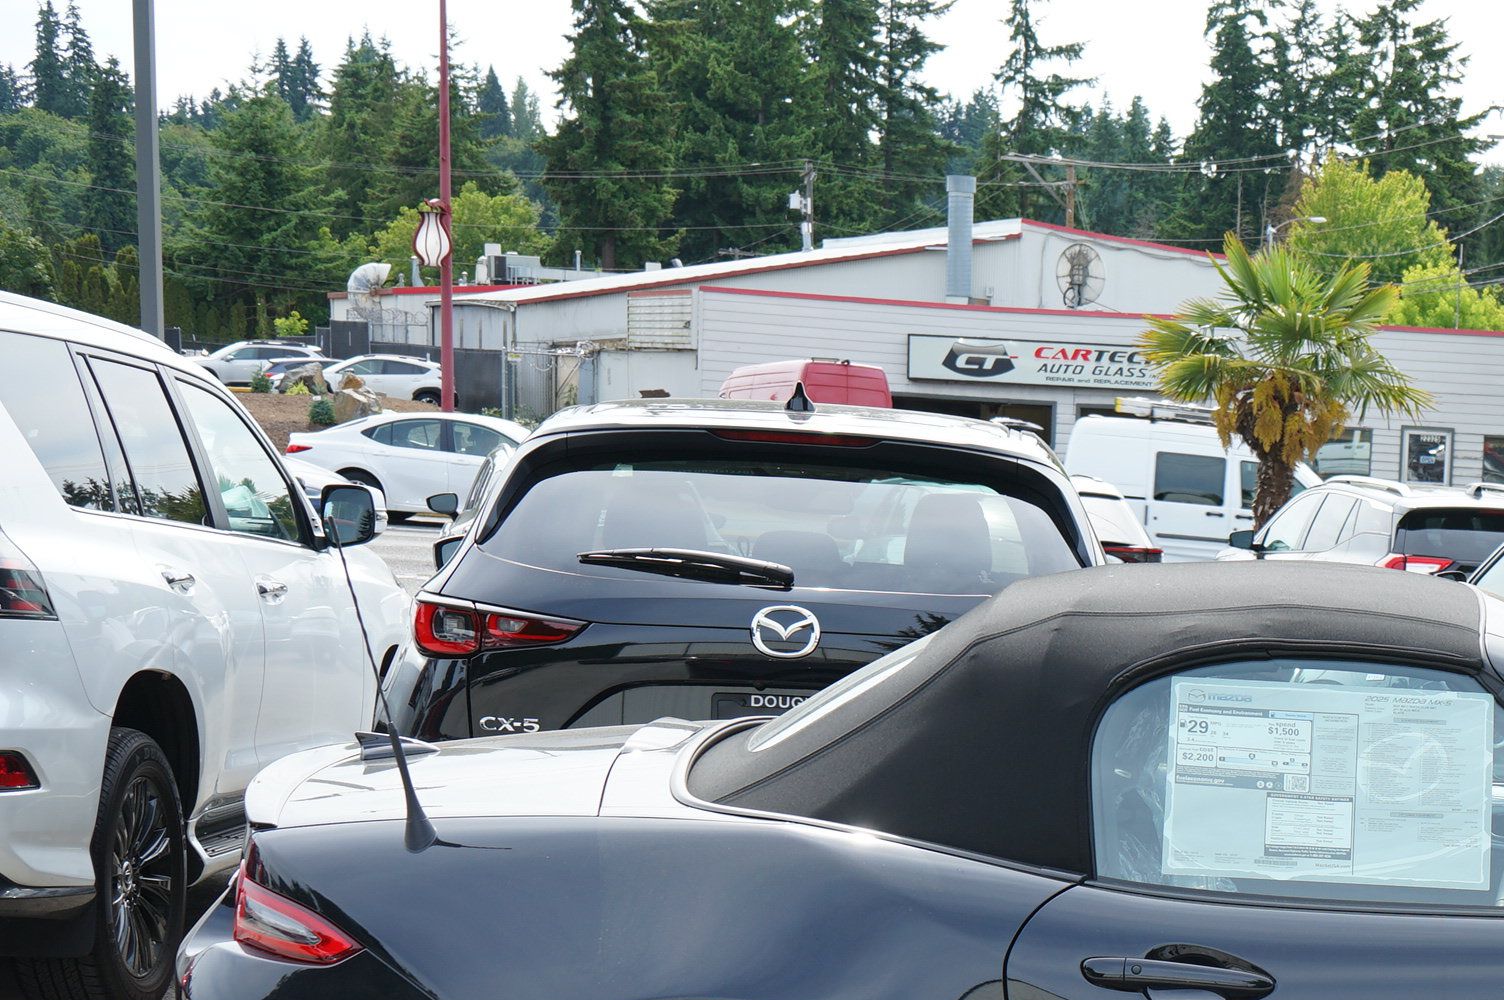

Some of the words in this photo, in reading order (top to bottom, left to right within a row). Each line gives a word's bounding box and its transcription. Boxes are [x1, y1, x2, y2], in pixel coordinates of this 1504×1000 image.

[1034, 346, 1152, 365] CARTEC
[1037, 363, 1085, 375] AUTO
[1092, 365, 1148, 378] GLASS
[1093, 379, 1153, 387] REPLACEMENT
[751, 695, 808, 709] DOUG
[479, 716, 541, 733] CX-5
[1187, 719, 1209, 734] 29
[1268, 726, 1300, 737] $1,500
[1182, 752, 1214, 762] $2,200
